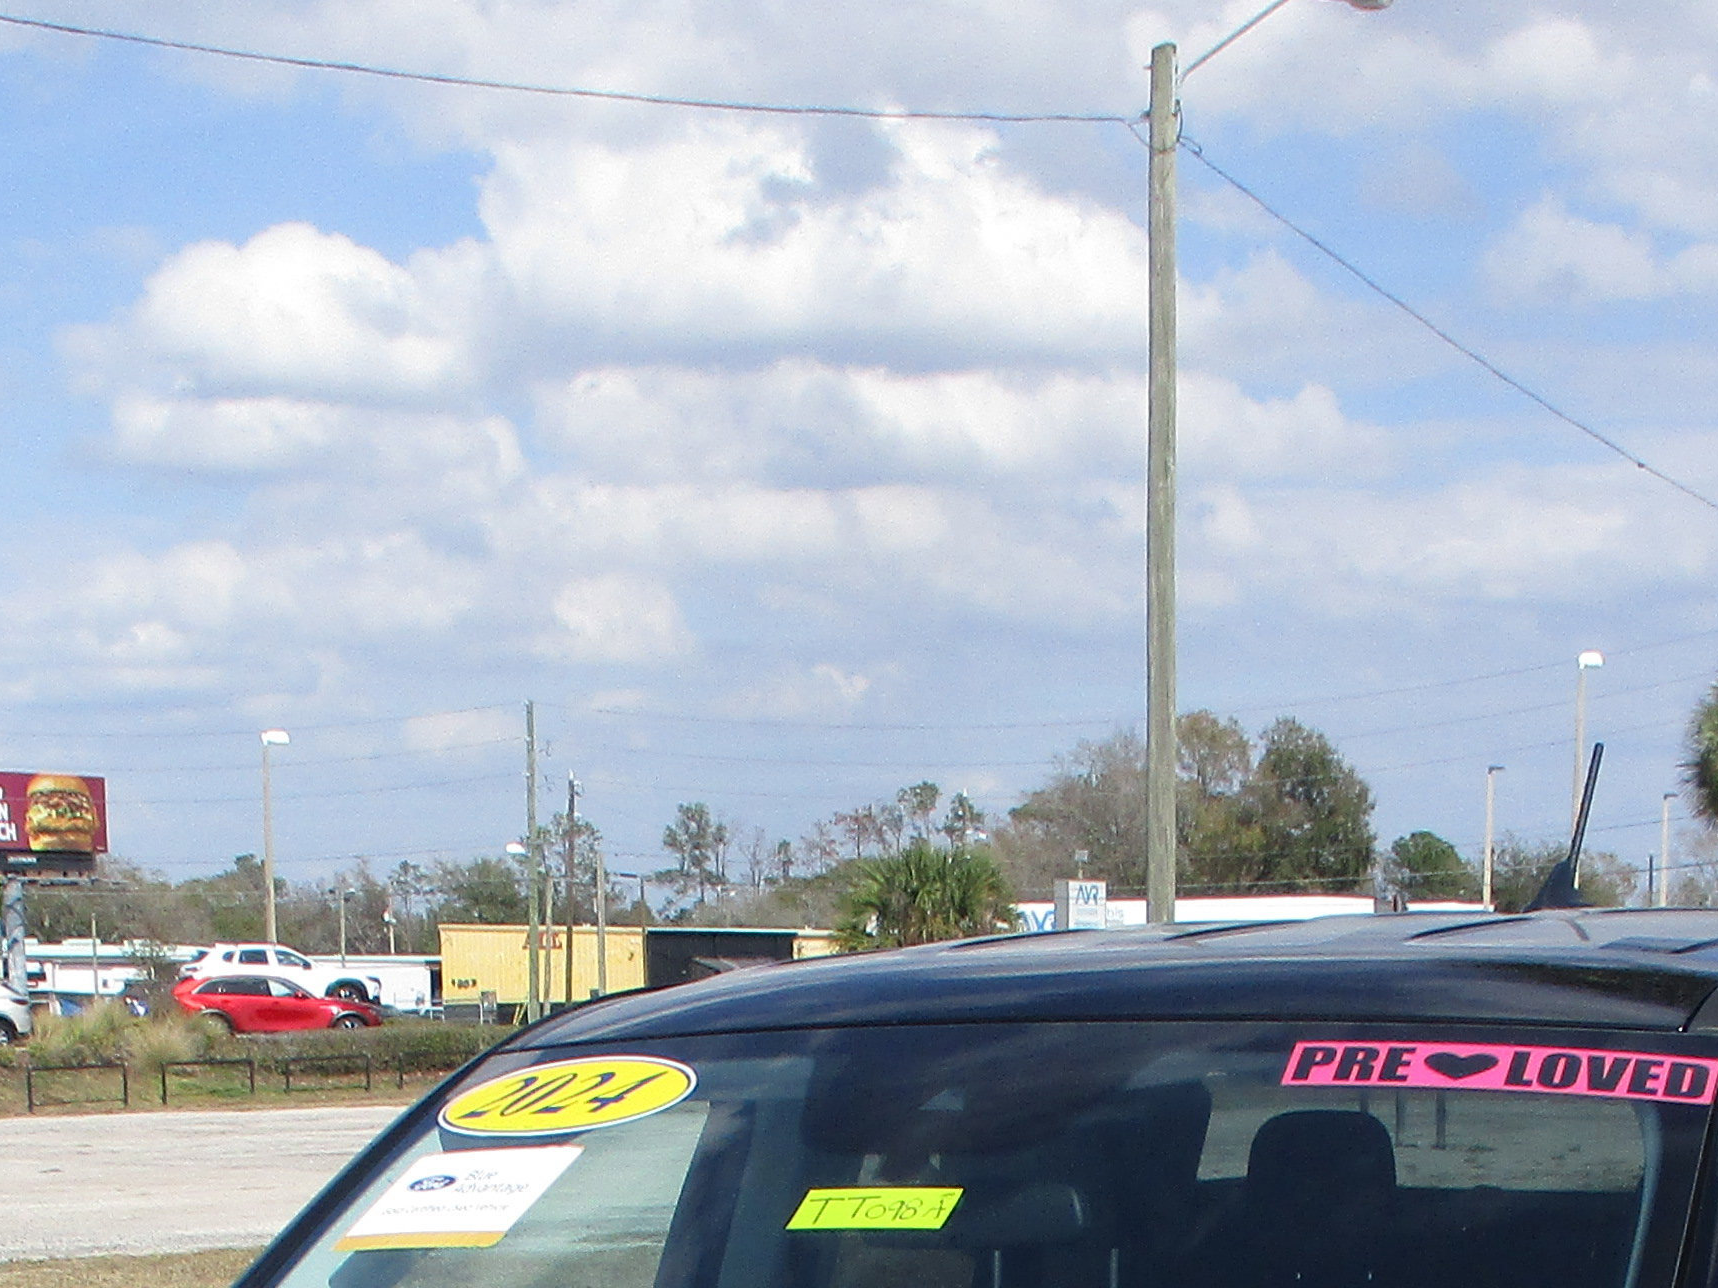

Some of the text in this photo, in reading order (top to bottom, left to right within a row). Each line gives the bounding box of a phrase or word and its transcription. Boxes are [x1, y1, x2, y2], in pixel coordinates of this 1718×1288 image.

[457, 1070, 672, 1119] 2024
[1292, 1045, 1711, 1100] PRE LOVED
